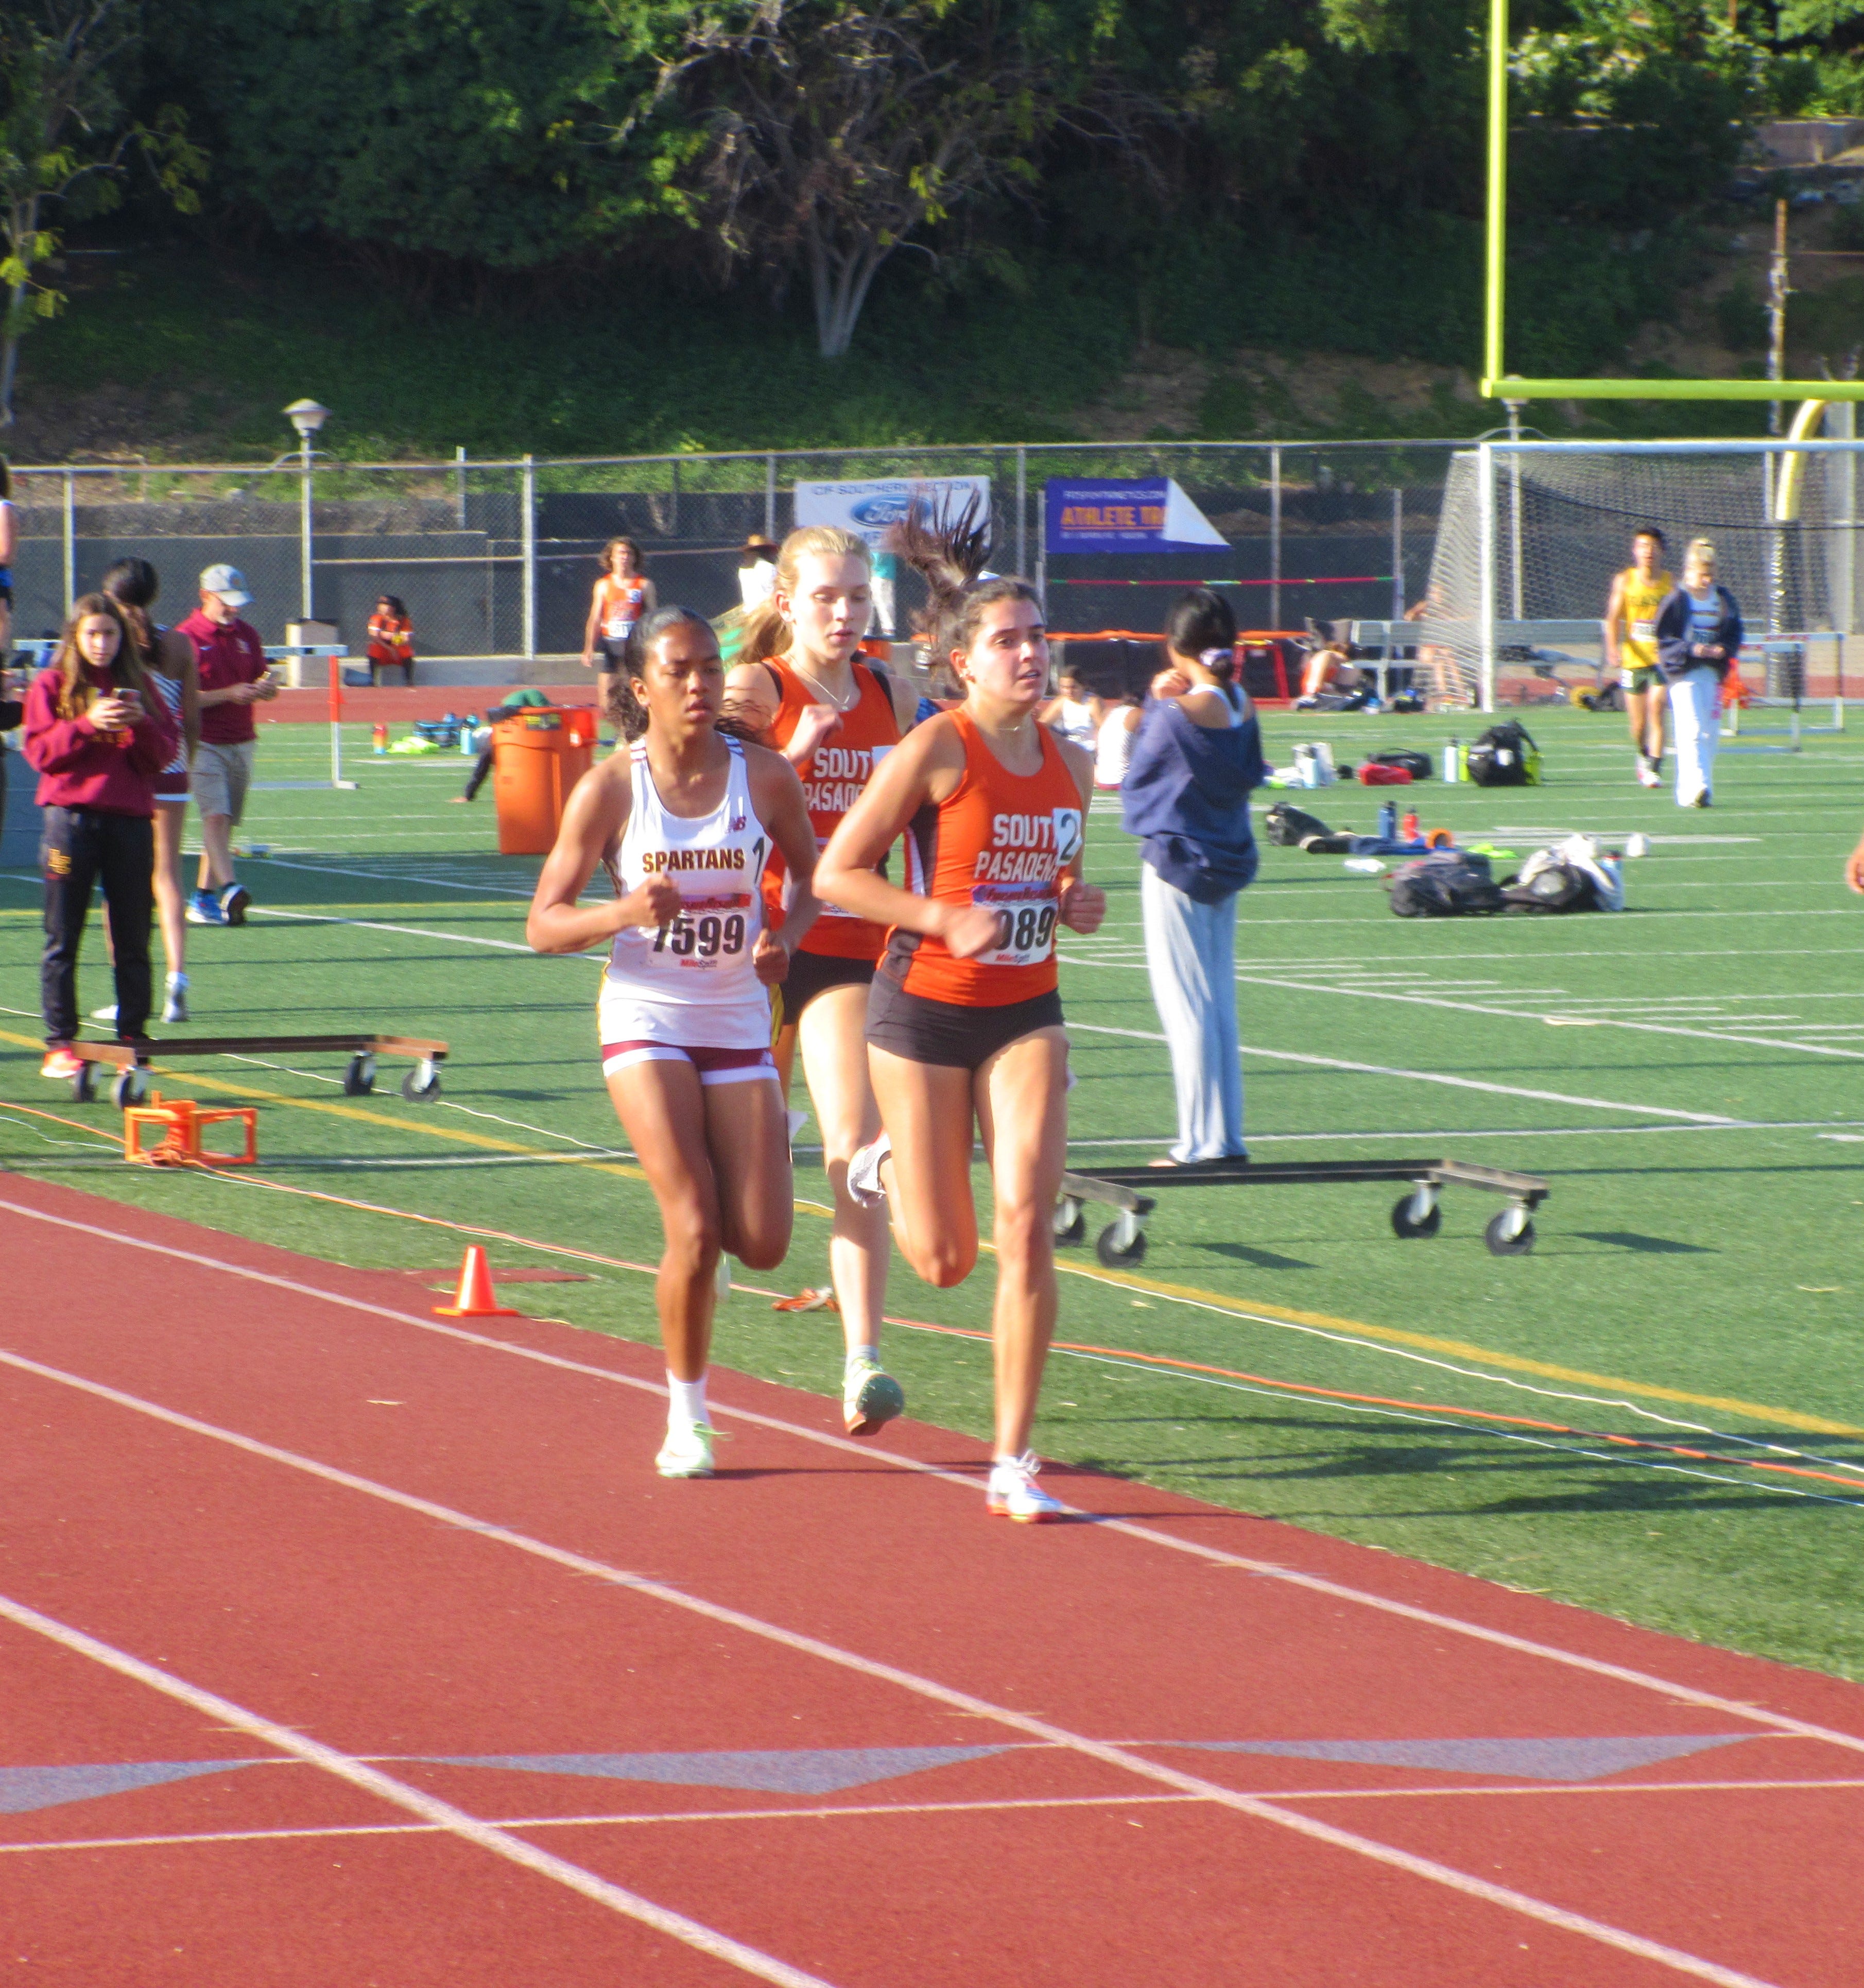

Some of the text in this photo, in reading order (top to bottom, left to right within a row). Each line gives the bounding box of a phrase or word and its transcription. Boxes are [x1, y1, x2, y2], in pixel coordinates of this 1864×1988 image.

[1061, 506, 1136, 525] ATHLETE
[814, 747, 871, 780] SOUT
[993, 813, 1057, 849] SOUT
[1060, 813, 1078, 861] 2
[643, 849, 745, 872] SPARTANS
[993, 906, 1055, 950] 089
